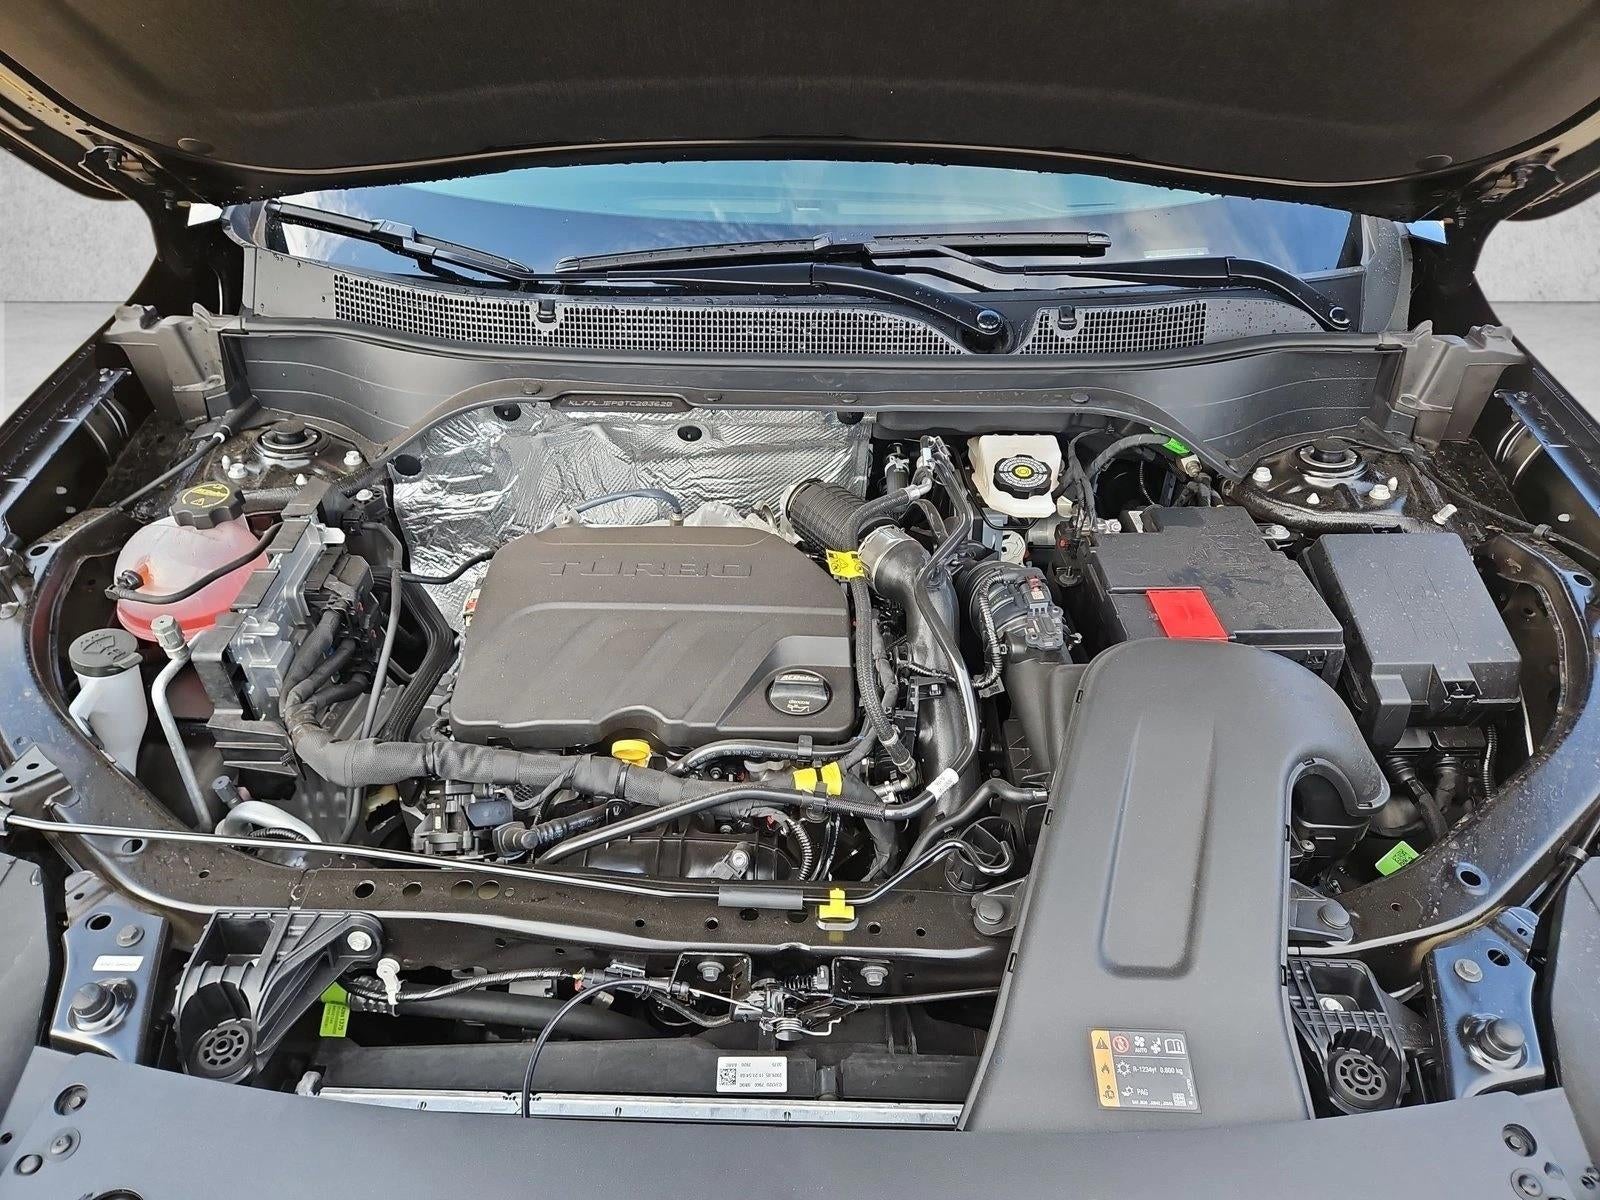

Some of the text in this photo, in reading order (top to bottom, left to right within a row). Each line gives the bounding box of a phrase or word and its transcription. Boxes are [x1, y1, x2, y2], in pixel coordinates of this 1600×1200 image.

[540, 561, 752, 578] TURBO
[1175, 1066, 1184, 1075] kg
[1136, 1088, 1149, 1096] PAG
